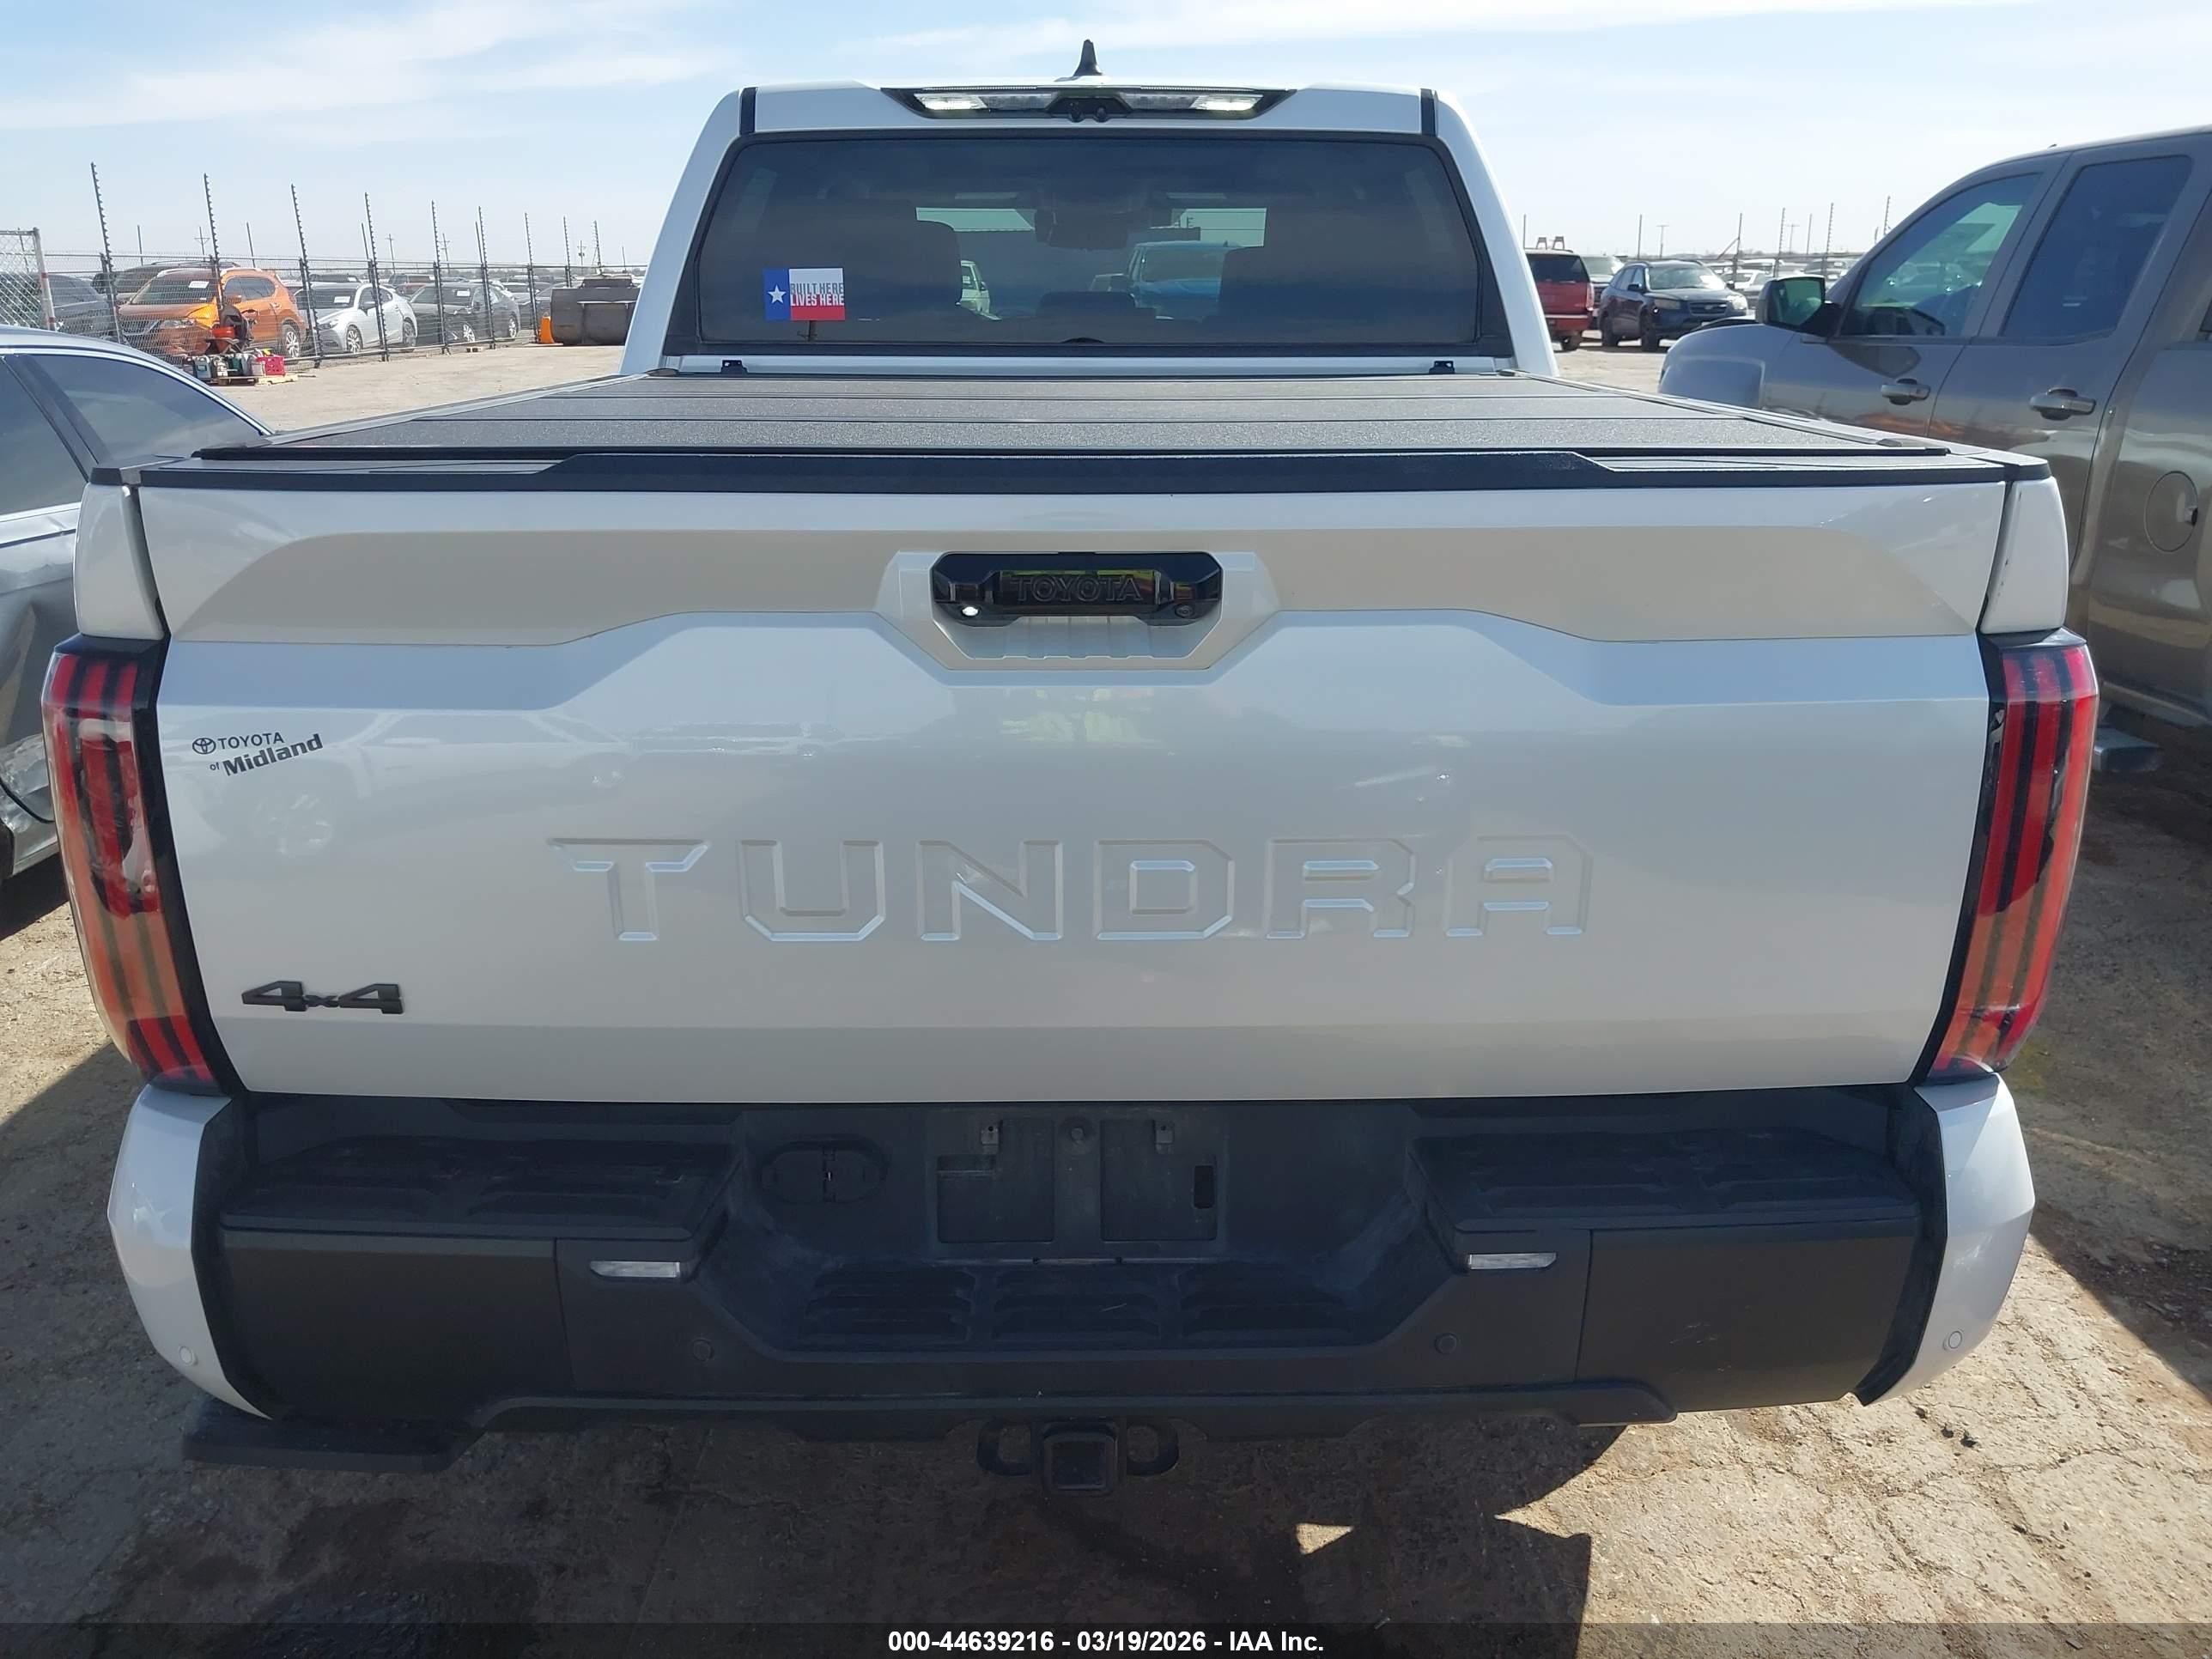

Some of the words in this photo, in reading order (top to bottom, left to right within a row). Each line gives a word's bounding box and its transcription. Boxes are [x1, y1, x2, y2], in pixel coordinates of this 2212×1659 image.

[790, 283, 818, 295] BUILT
[819, 283, 843, 295] HERE
[790, 294, 817, 307] LIVES
[820, 294, 845, 307] HERE
[1011, 575, 1143, 602] TOYOTA
[217, 732, 285, 750] TOYOTA
[210, 762, 220, 771] of
[222, 733, 324, 776] Midland
[547, 835, 1595, 943] TUNDRA
